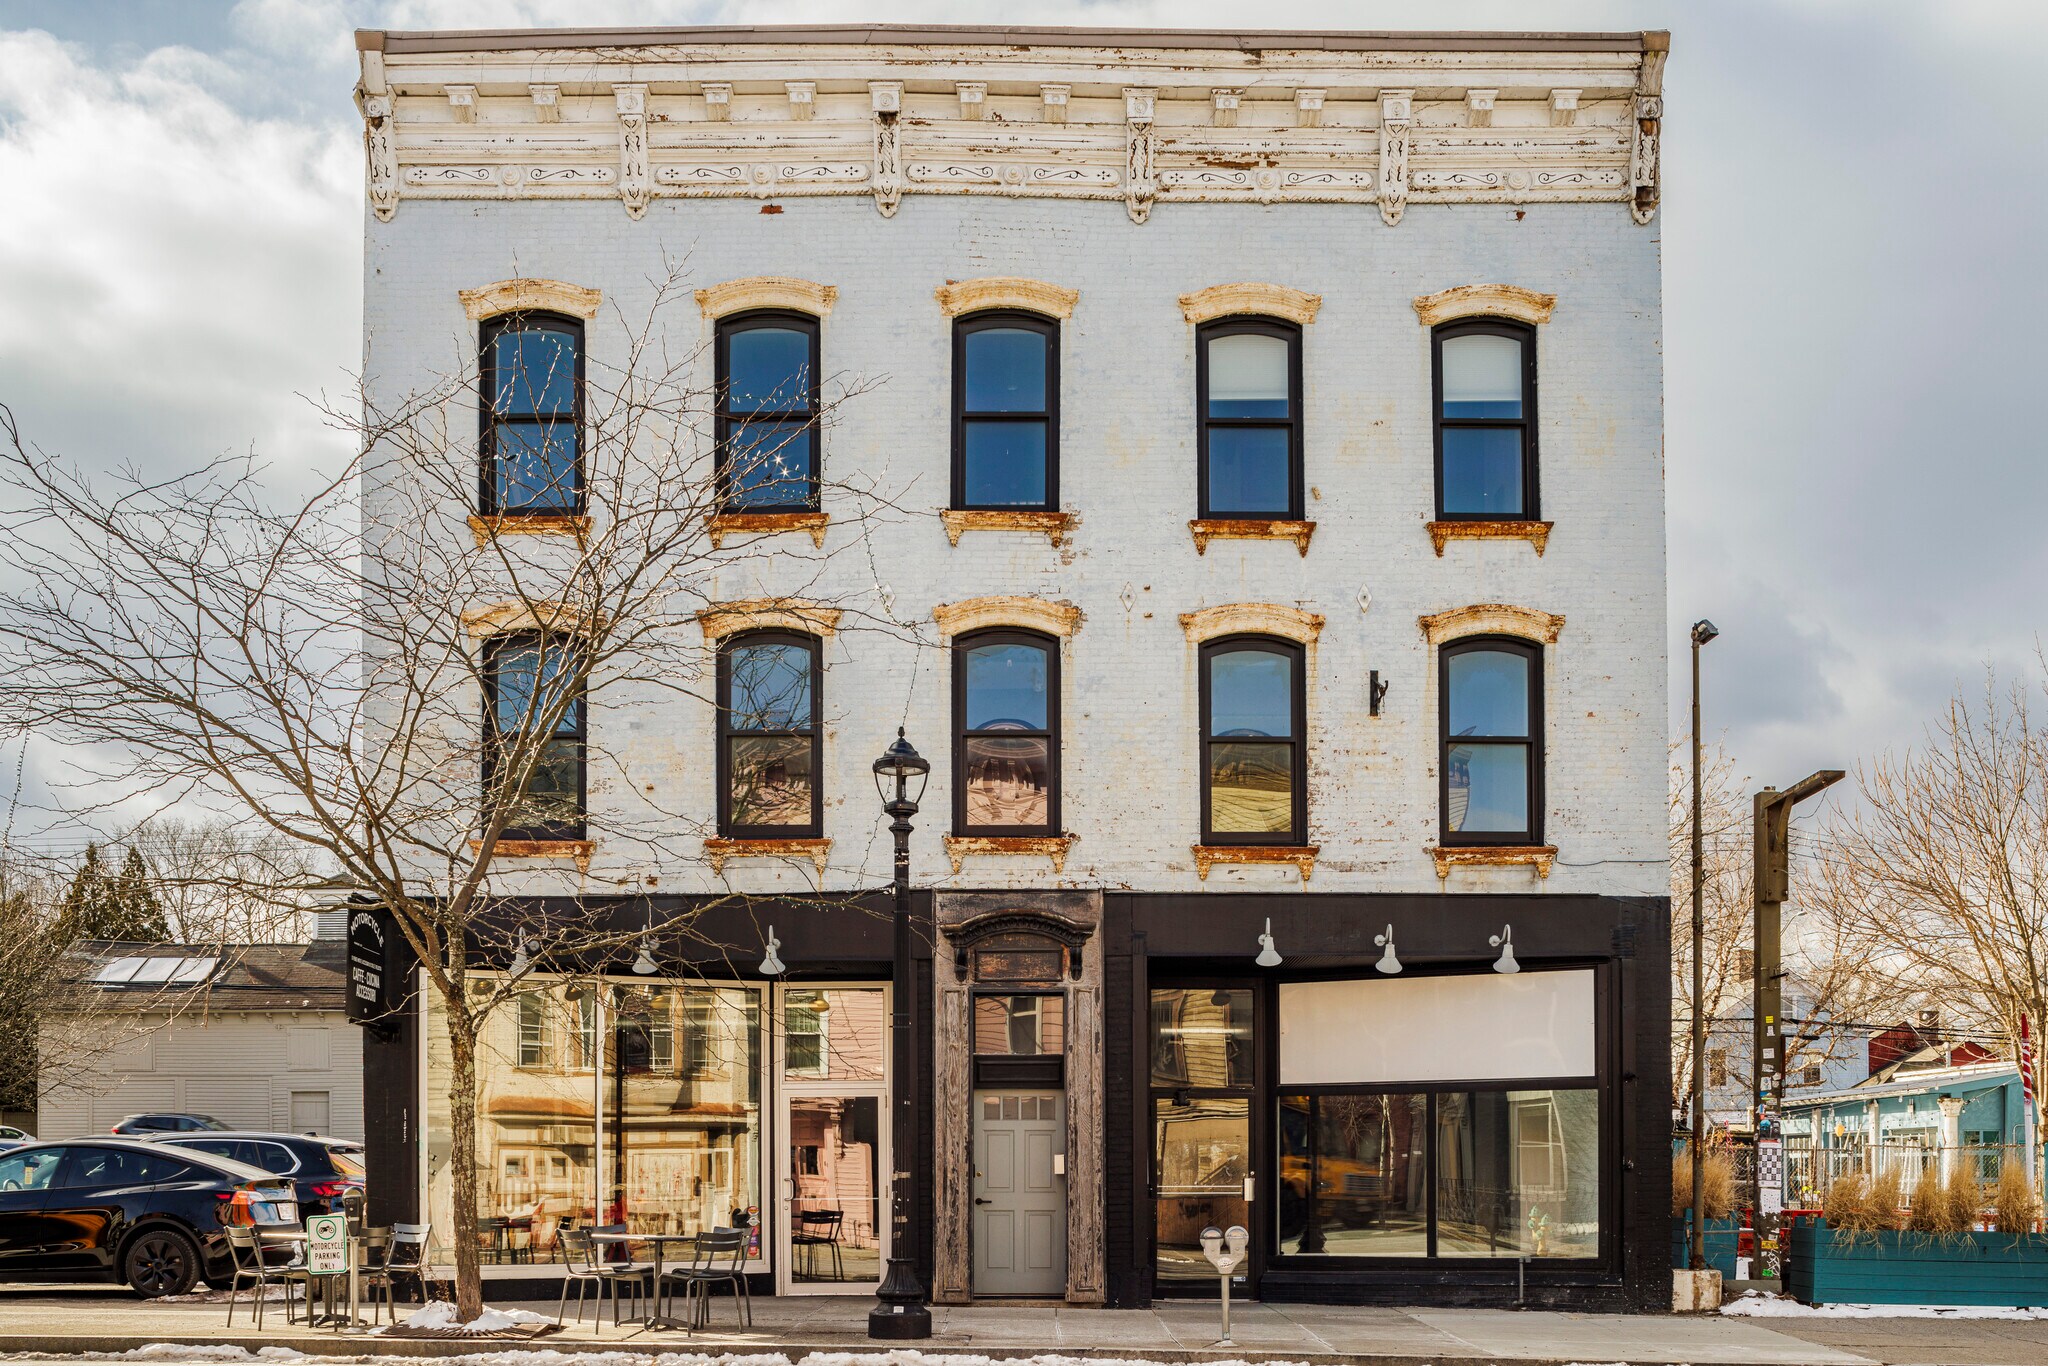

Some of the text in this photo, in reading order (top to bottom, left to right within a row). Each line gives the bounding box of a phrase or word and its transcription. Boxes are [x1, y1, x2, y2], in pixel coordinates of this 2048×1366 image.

[350, 912, 384, 947] MOTORCYCLE
[352, 967, 364, 983] CAFFE
[310, 1242, 344, 1250] MOTORCYCLE
[315, 1252, 340, 1260] PARKING
